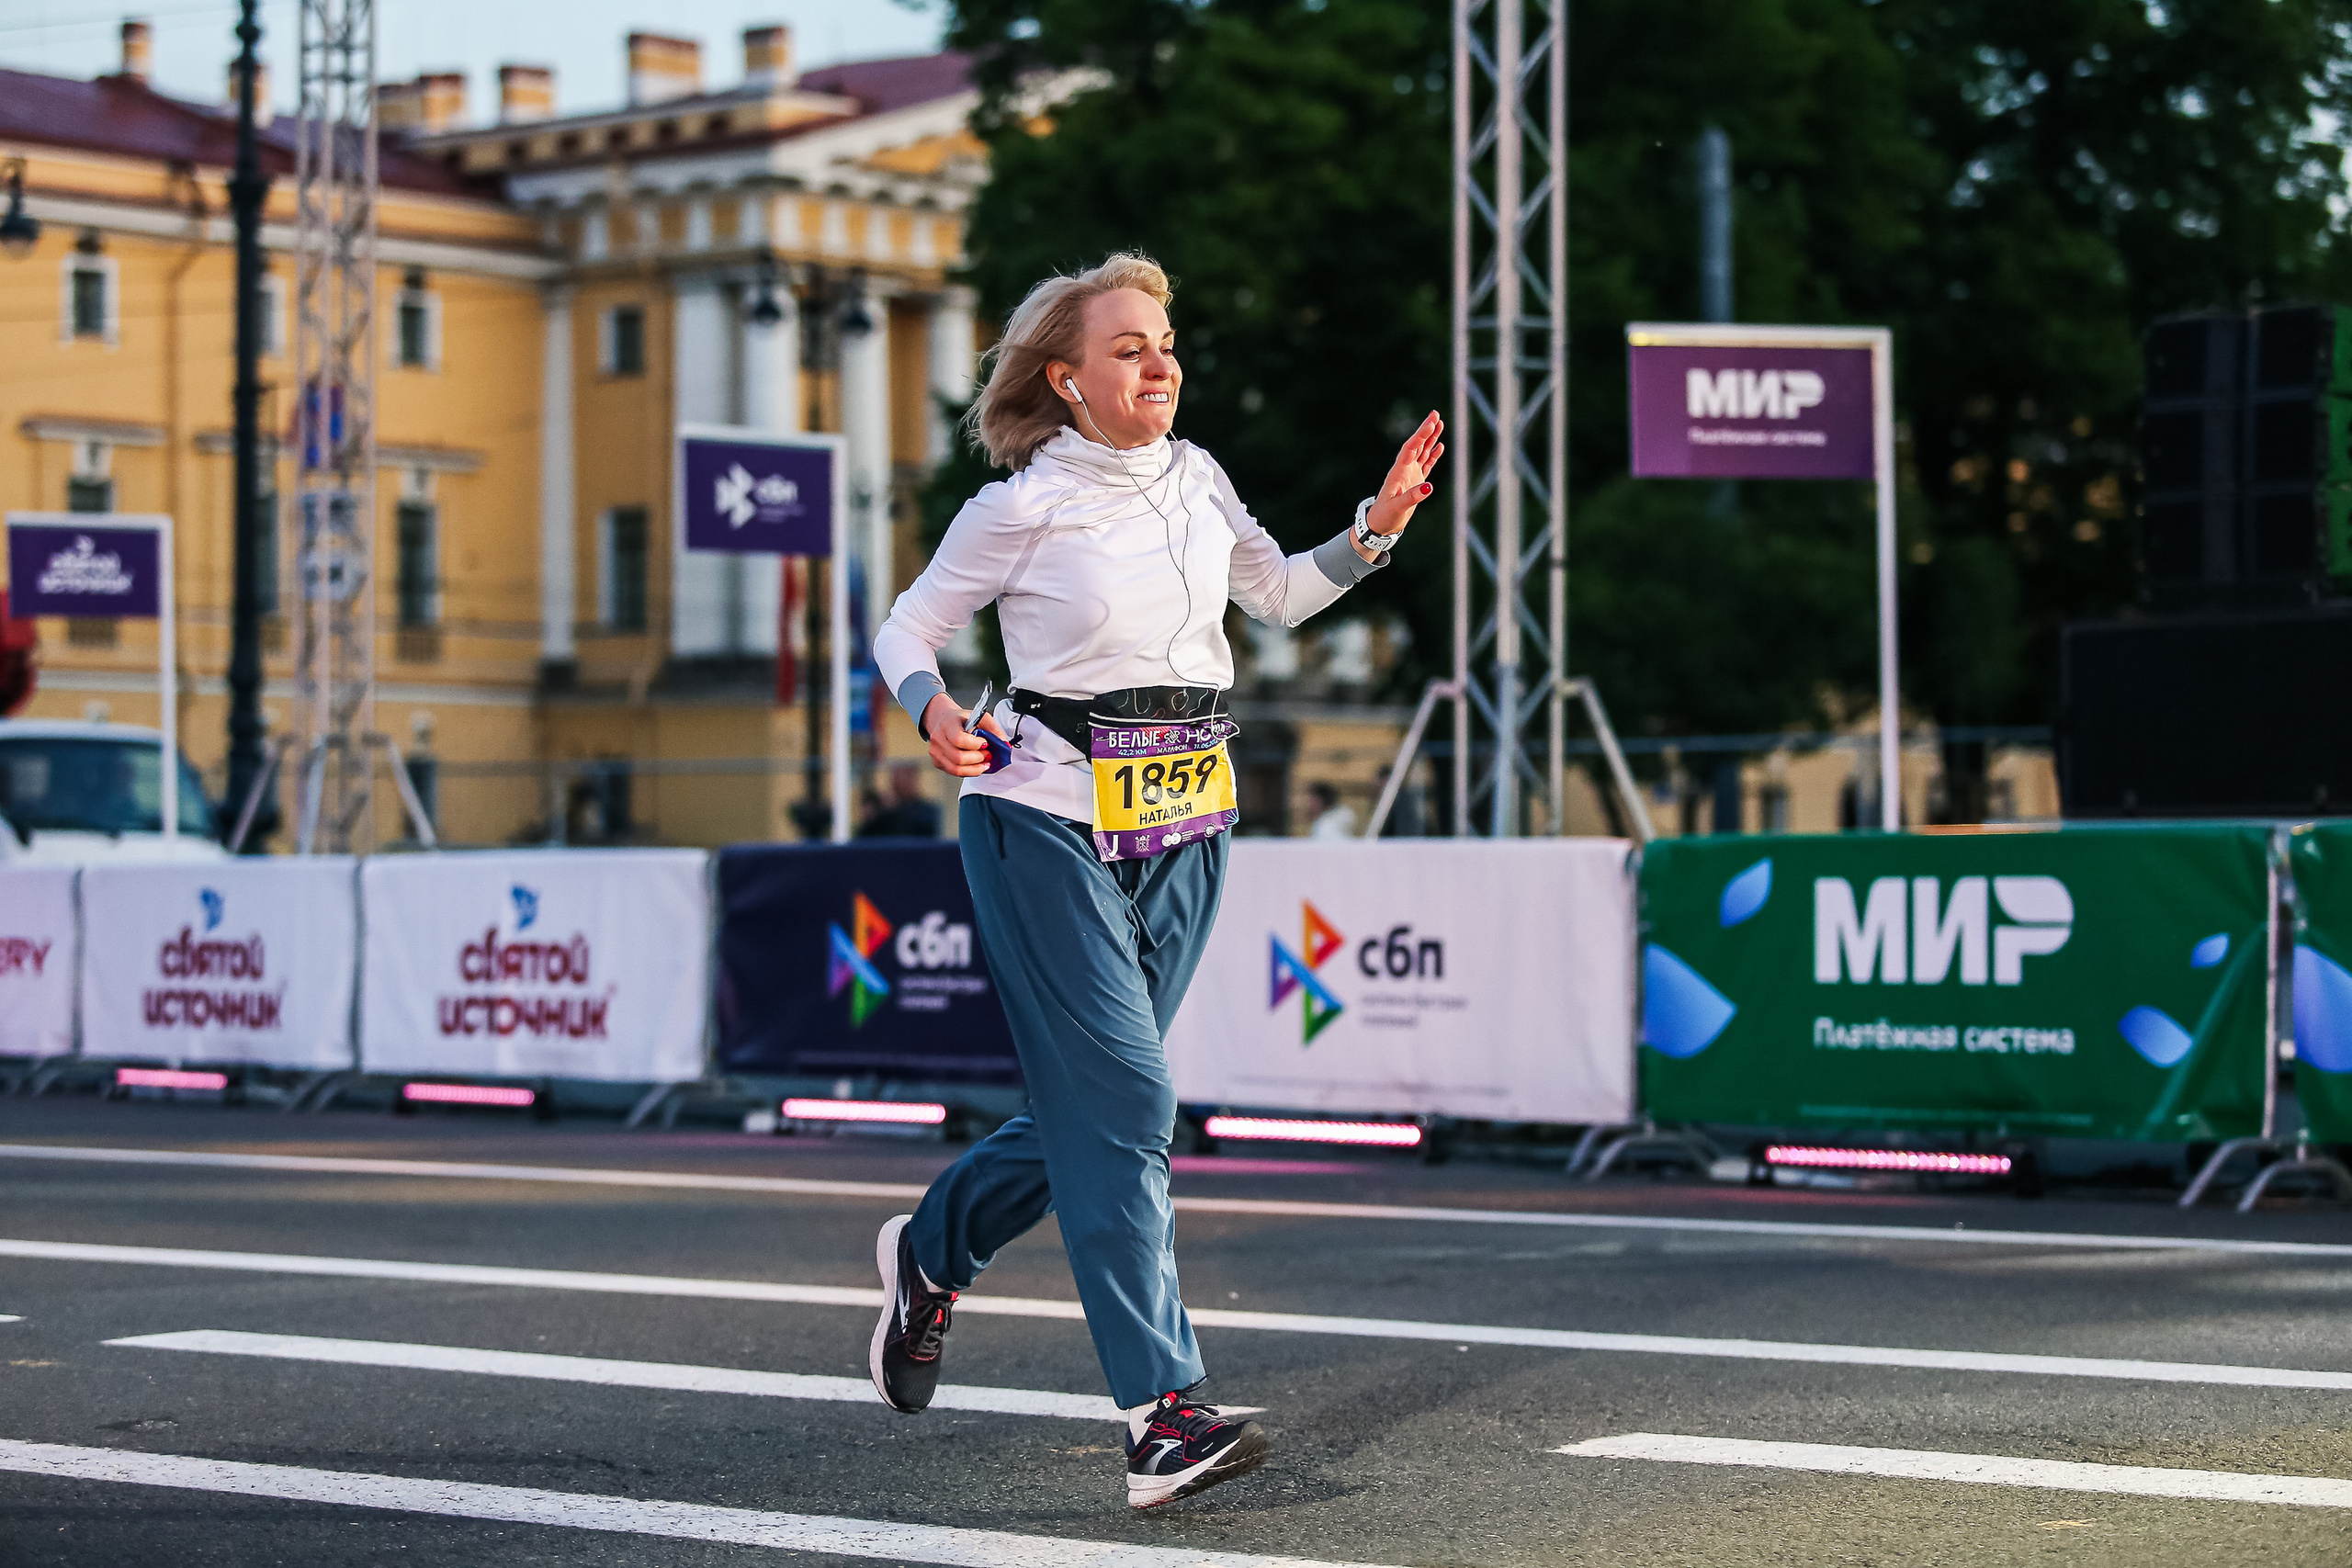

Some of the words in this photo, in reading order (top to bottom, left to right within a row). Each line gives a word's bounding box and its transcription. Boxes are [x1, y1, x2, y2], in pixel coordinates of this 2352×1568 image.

[1687, 368, 1825, 419] МИР
[1108, 730, 1160, 749] БЕЛЫЕ
[1157, 744, 1188, 754] МАРАФОН
[1114, 754, 1217, 809] 1859
[1139, 802, 1193, 826] НАТАЛЬЯ
[896, 911, 972, 969] сбп
[1358, 924, 1445, 980] сбп
[1814, 875, 2075, 986] МИР
[1814, 1016, 1959, 1051] Платёжная
[1962, 1026, 2075, 1055] система
